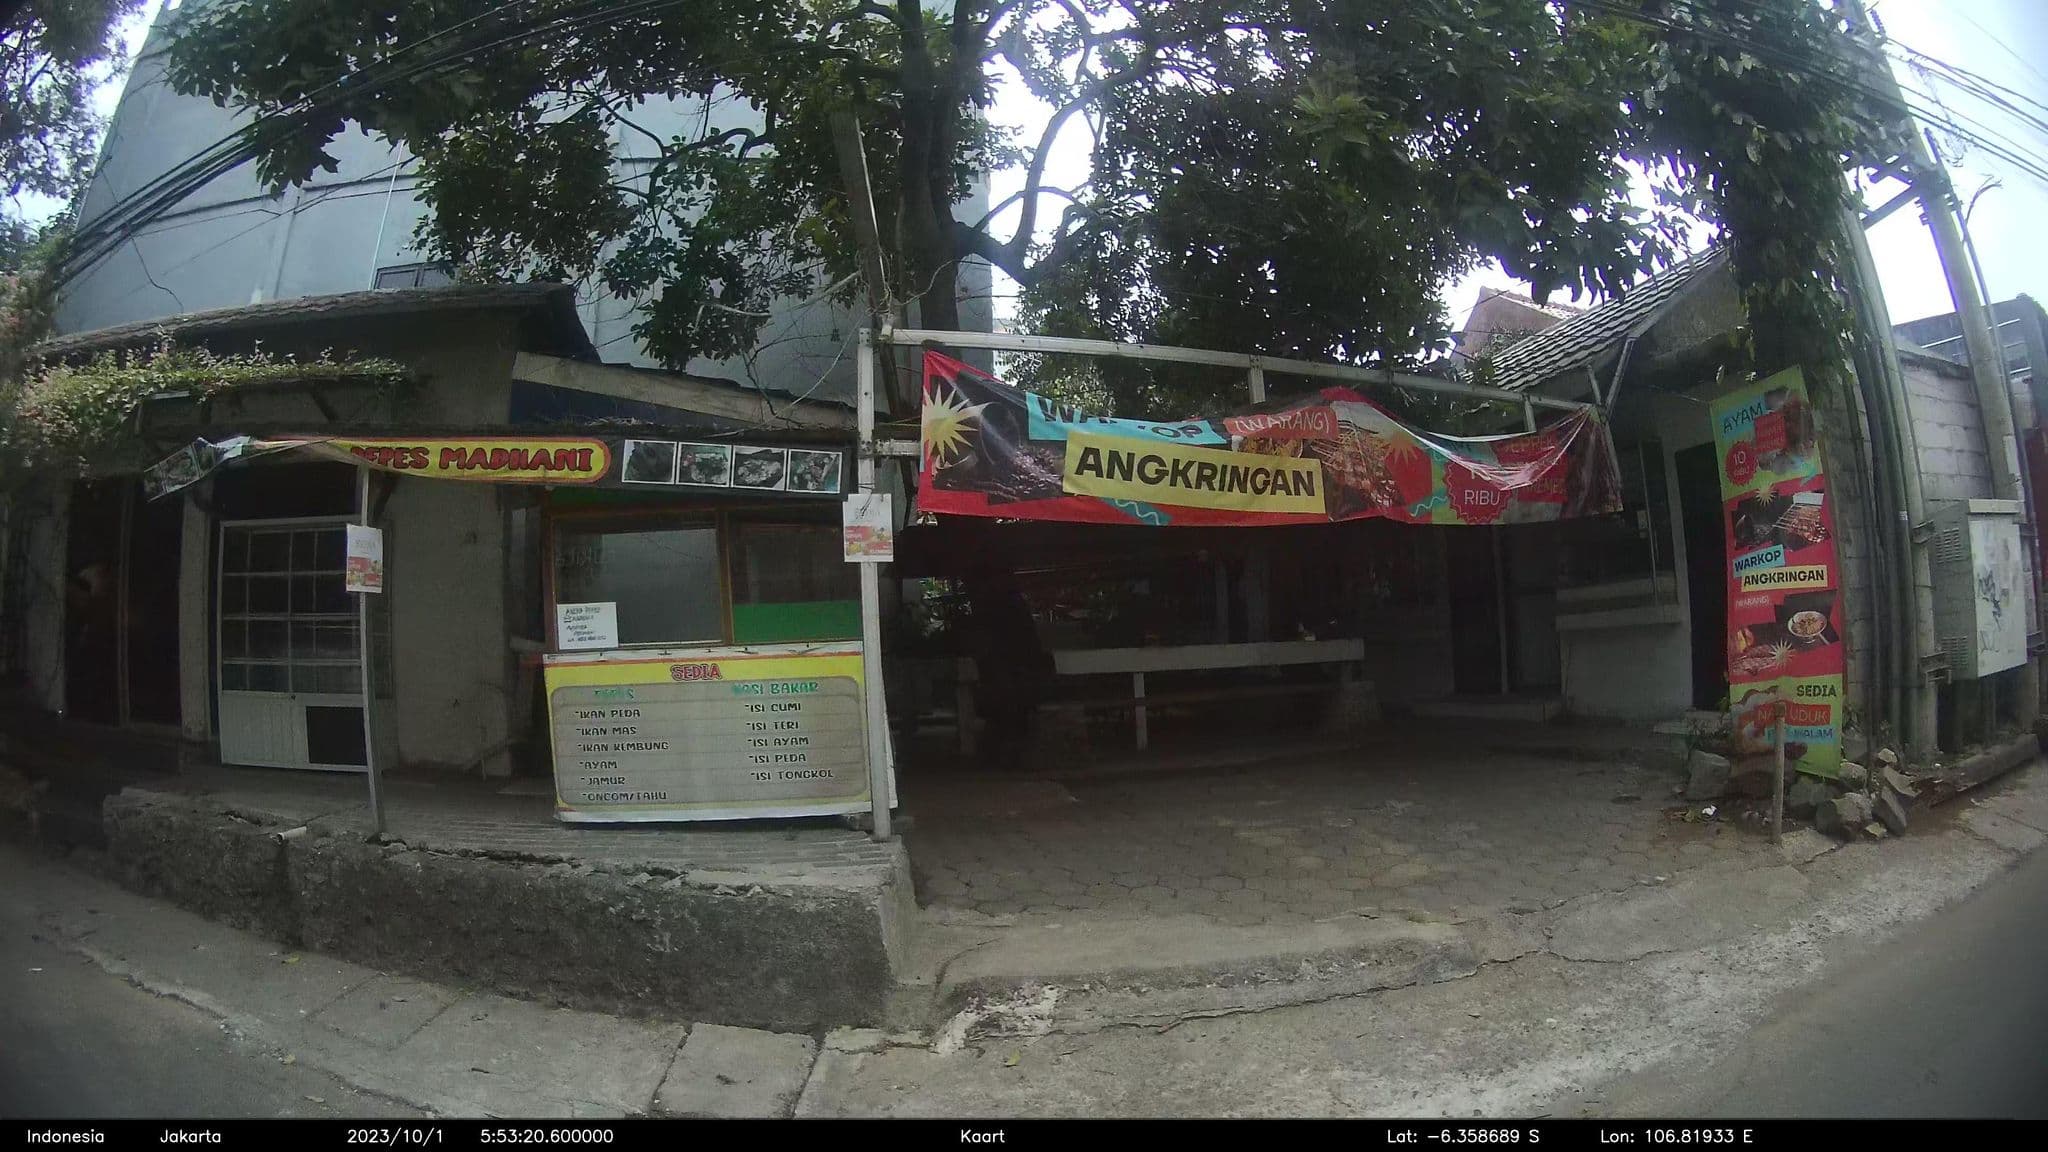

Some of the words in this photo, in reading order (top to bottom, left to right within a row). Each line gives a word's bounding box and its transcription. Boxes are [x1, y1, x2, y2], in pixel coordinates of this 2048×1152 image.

[1723, 402, 1764, 434] AYAM
[439, 447, 594, 472] MADHANI
[1074, 446, 1316, 497] ANGKRINGAN
[1463, 489, 1500, 506] RIBU
[1734, 550, 1781, 572] WARKOP
[1743, 569, 1825, 586] ANGKRINGAN
[670, 664, 723, 681] SEDIA
[771, 682, 818, 695] BAKAR
[1796, 684, 1837, 697] SEDIA
[611, 709, 641, 718] PEDA
[771, 703, 801, 712] CUMI
[612, 726, 637, 735] MAS
[773, 721, 799, 730] TERI
[614, 742, 669, 751] KEMBUNG
[774, 737, 809, 746] AYAM
[775, 753, 806, 763] PEDA
[776, 769, 834, 780] TONGKOL
